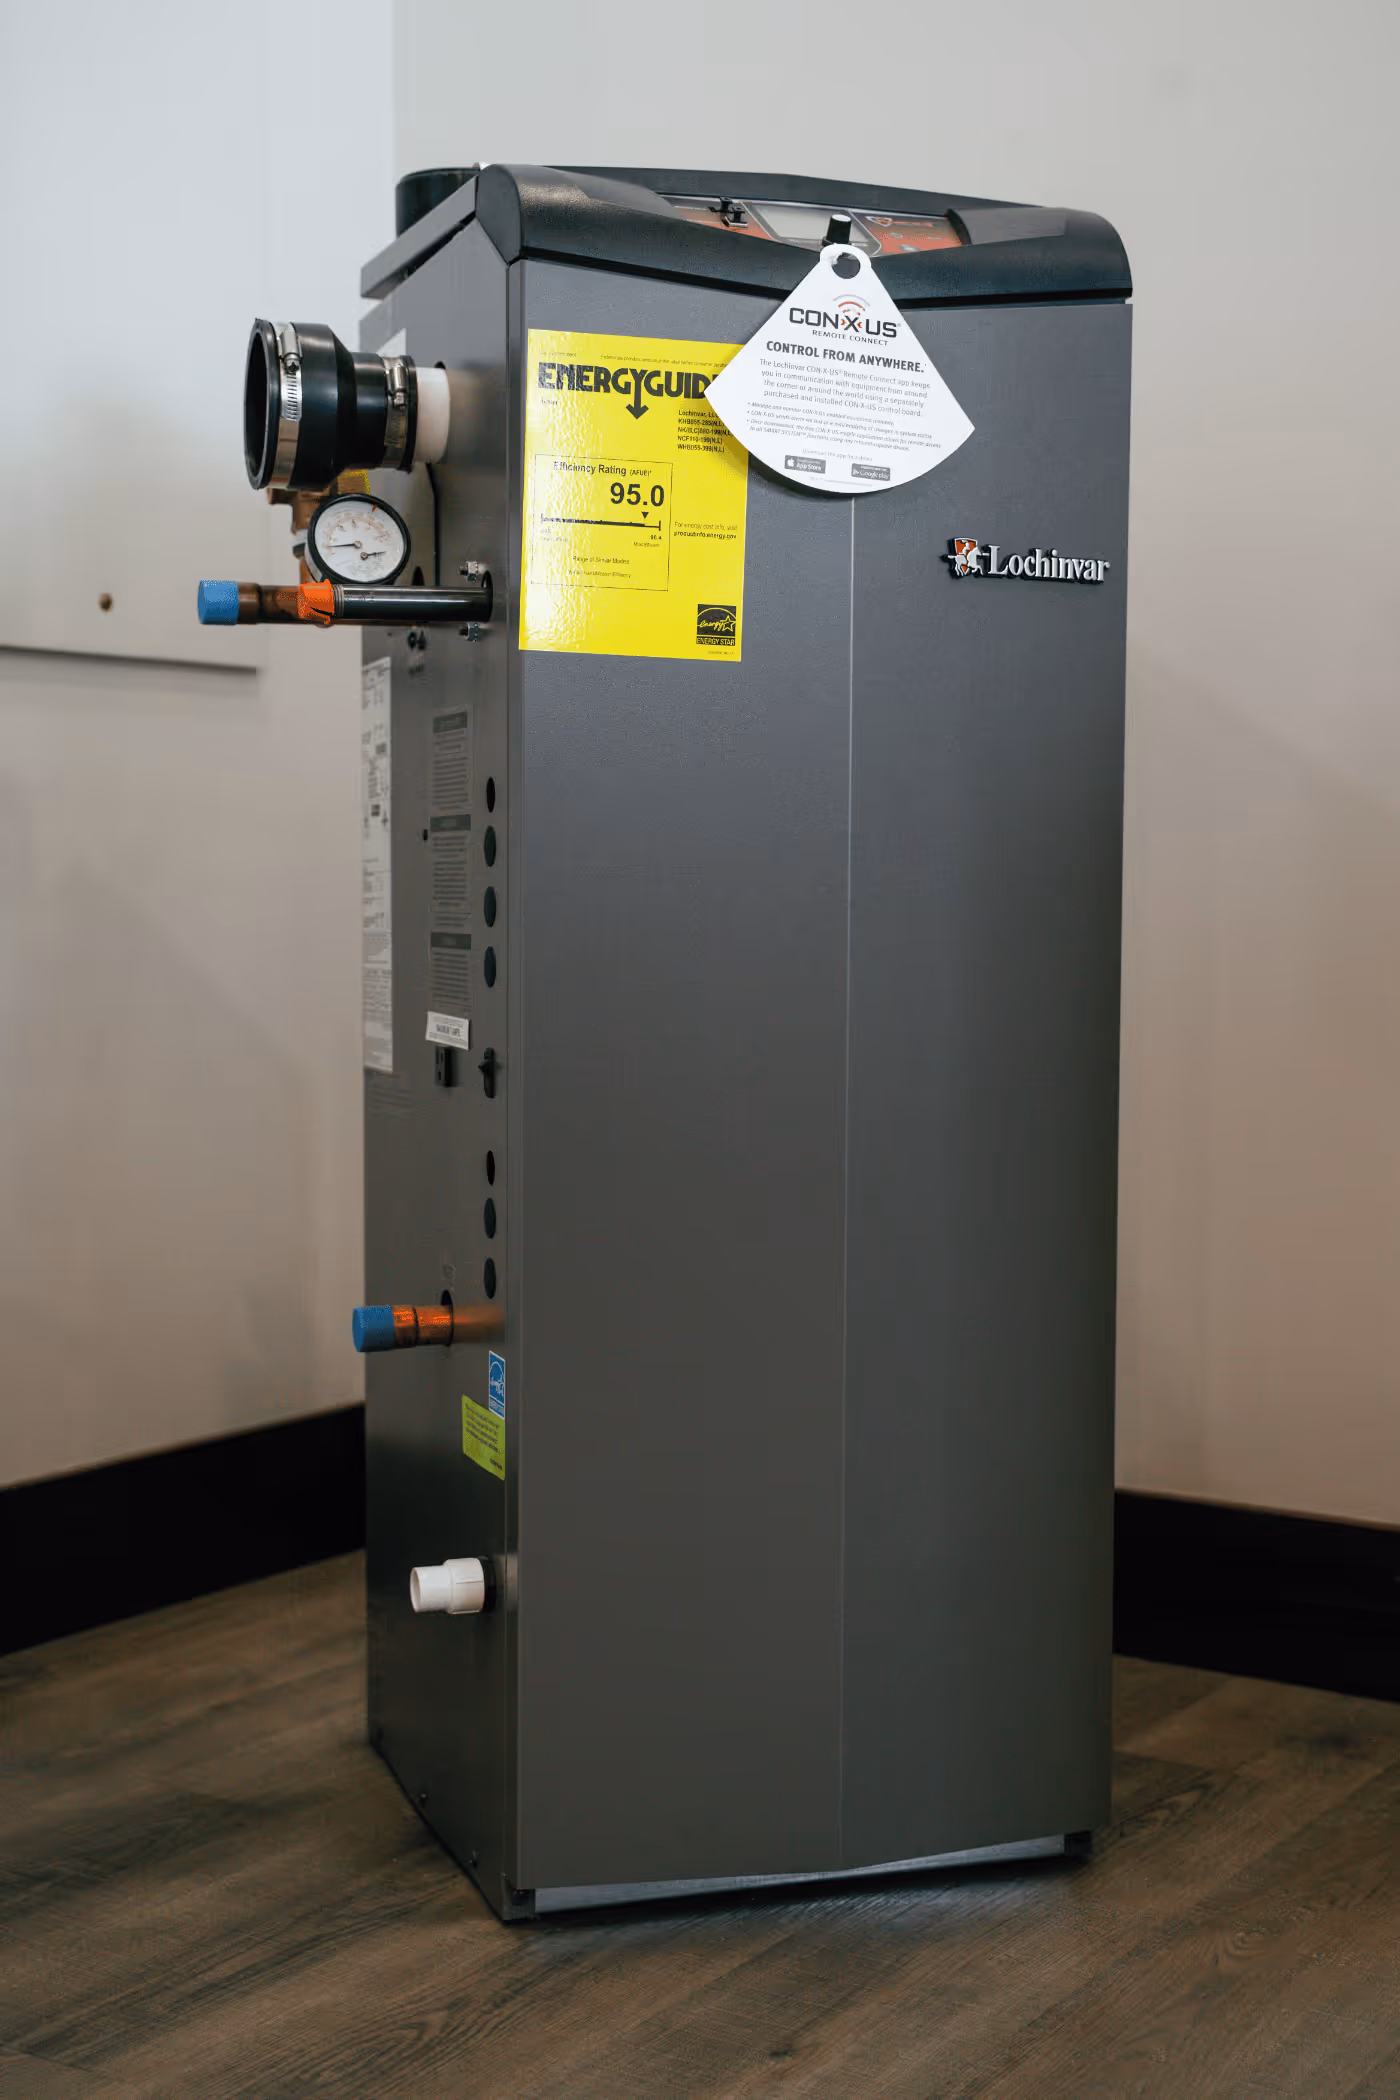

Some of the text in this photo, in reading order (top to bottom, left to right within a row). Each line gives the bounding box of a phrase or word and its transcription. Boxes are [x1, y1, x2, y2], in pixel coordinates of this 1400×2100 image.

[812, 329, 888, 346] REMOTE CONNECT
[766, 340, 924, 373] CONTROL FROM ANYWHERE.
[760, 358, 771, 366] The
[773, 361, 805, 371] Lochinvar
[844, 370, 868, 380] Remote
[870, 374, 896, 384] Connect
[898, 379, 909, 388] app
[911, 380, 930, 389] keeps
[761, 370, 928, 399] you in communication with equipment from around
[763, 390, 799, 400] purchased
[814, 396, 843, 406] installed
[878, 406, 900, 415] control
[902, 408, 923, 417] board.
[764, 378, 774, 386] the
[777, 382, 798, 390] corner
[808, 386, 831, 395] around
[833, 388, 843, 396] the
[845, 391, 863, 399] world
[865, 394, 883, 403] using
[890, 398, 924, 409] separately
[678, 409, 707, 418] Lochinvar,
[553, 461, 596, 475] Efficiency
[598, 464, 627, 477] Rating
[796, 462, 822, 472] App Store
[860, 470, 890, 480] Google play
[610, 482, 665, 507] 95.0
[988, 544, 1110, 582] Lochinvar
[696, 637, 735, 646] ENERGY STAR
